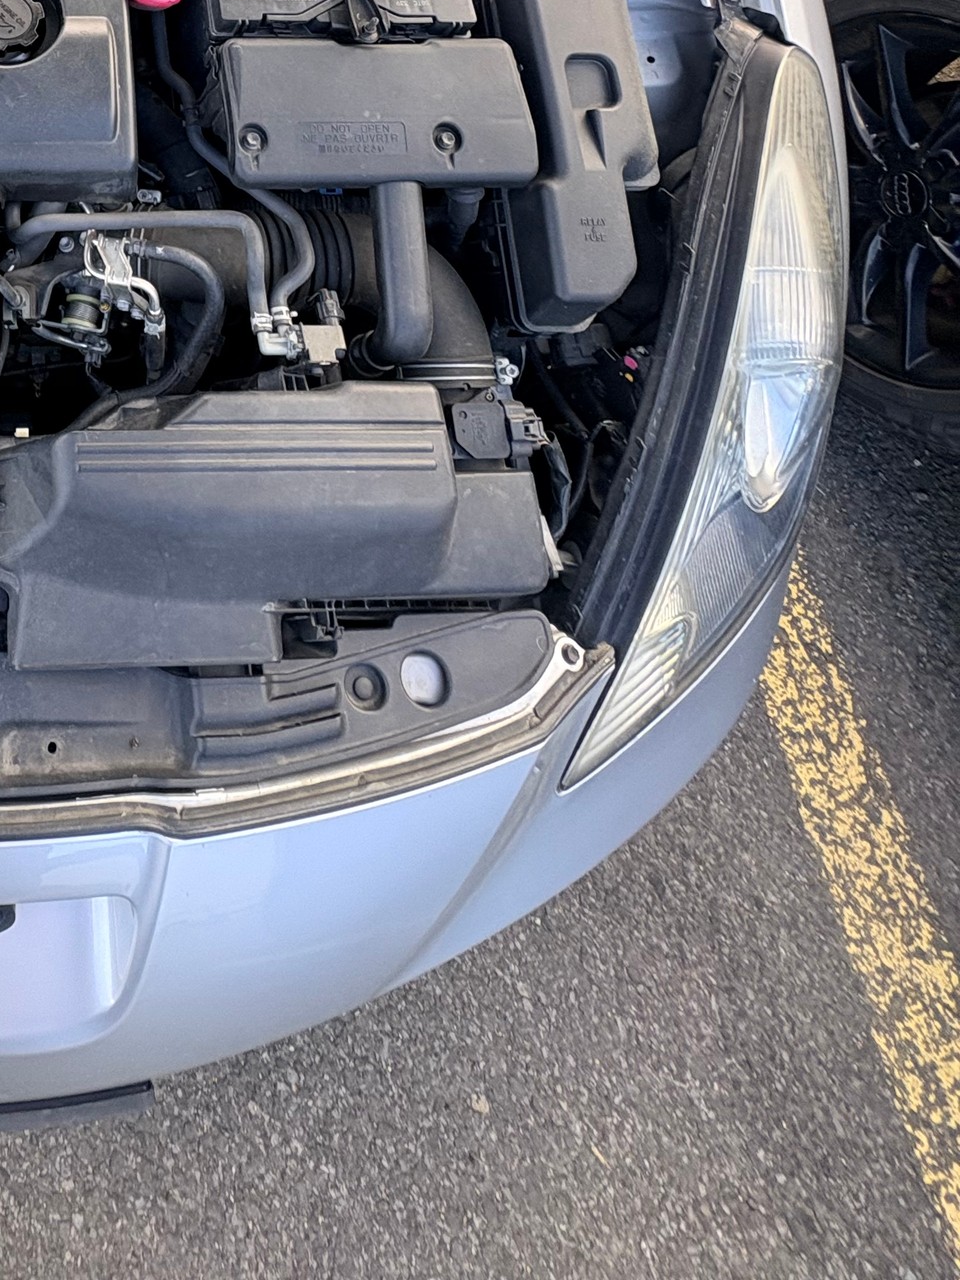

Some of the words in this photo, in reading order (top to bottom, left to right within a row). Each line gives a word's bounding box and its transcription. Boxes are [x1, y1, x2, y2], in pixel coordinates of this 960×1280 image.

[16, 17, 26, 28] OIL
[310, 124, 324, 134] DO
[330, 124, 351, 133] NOT
[360, 124, 390, 133] OPEN
[301, 134, 318, 144] NE
[325, 134, 348, 144] PAS
[354, 134, 399, 144] OUVRIR
[580, 216, 607, 226] RELAY
[584, 232, 607, 242] FUSE
